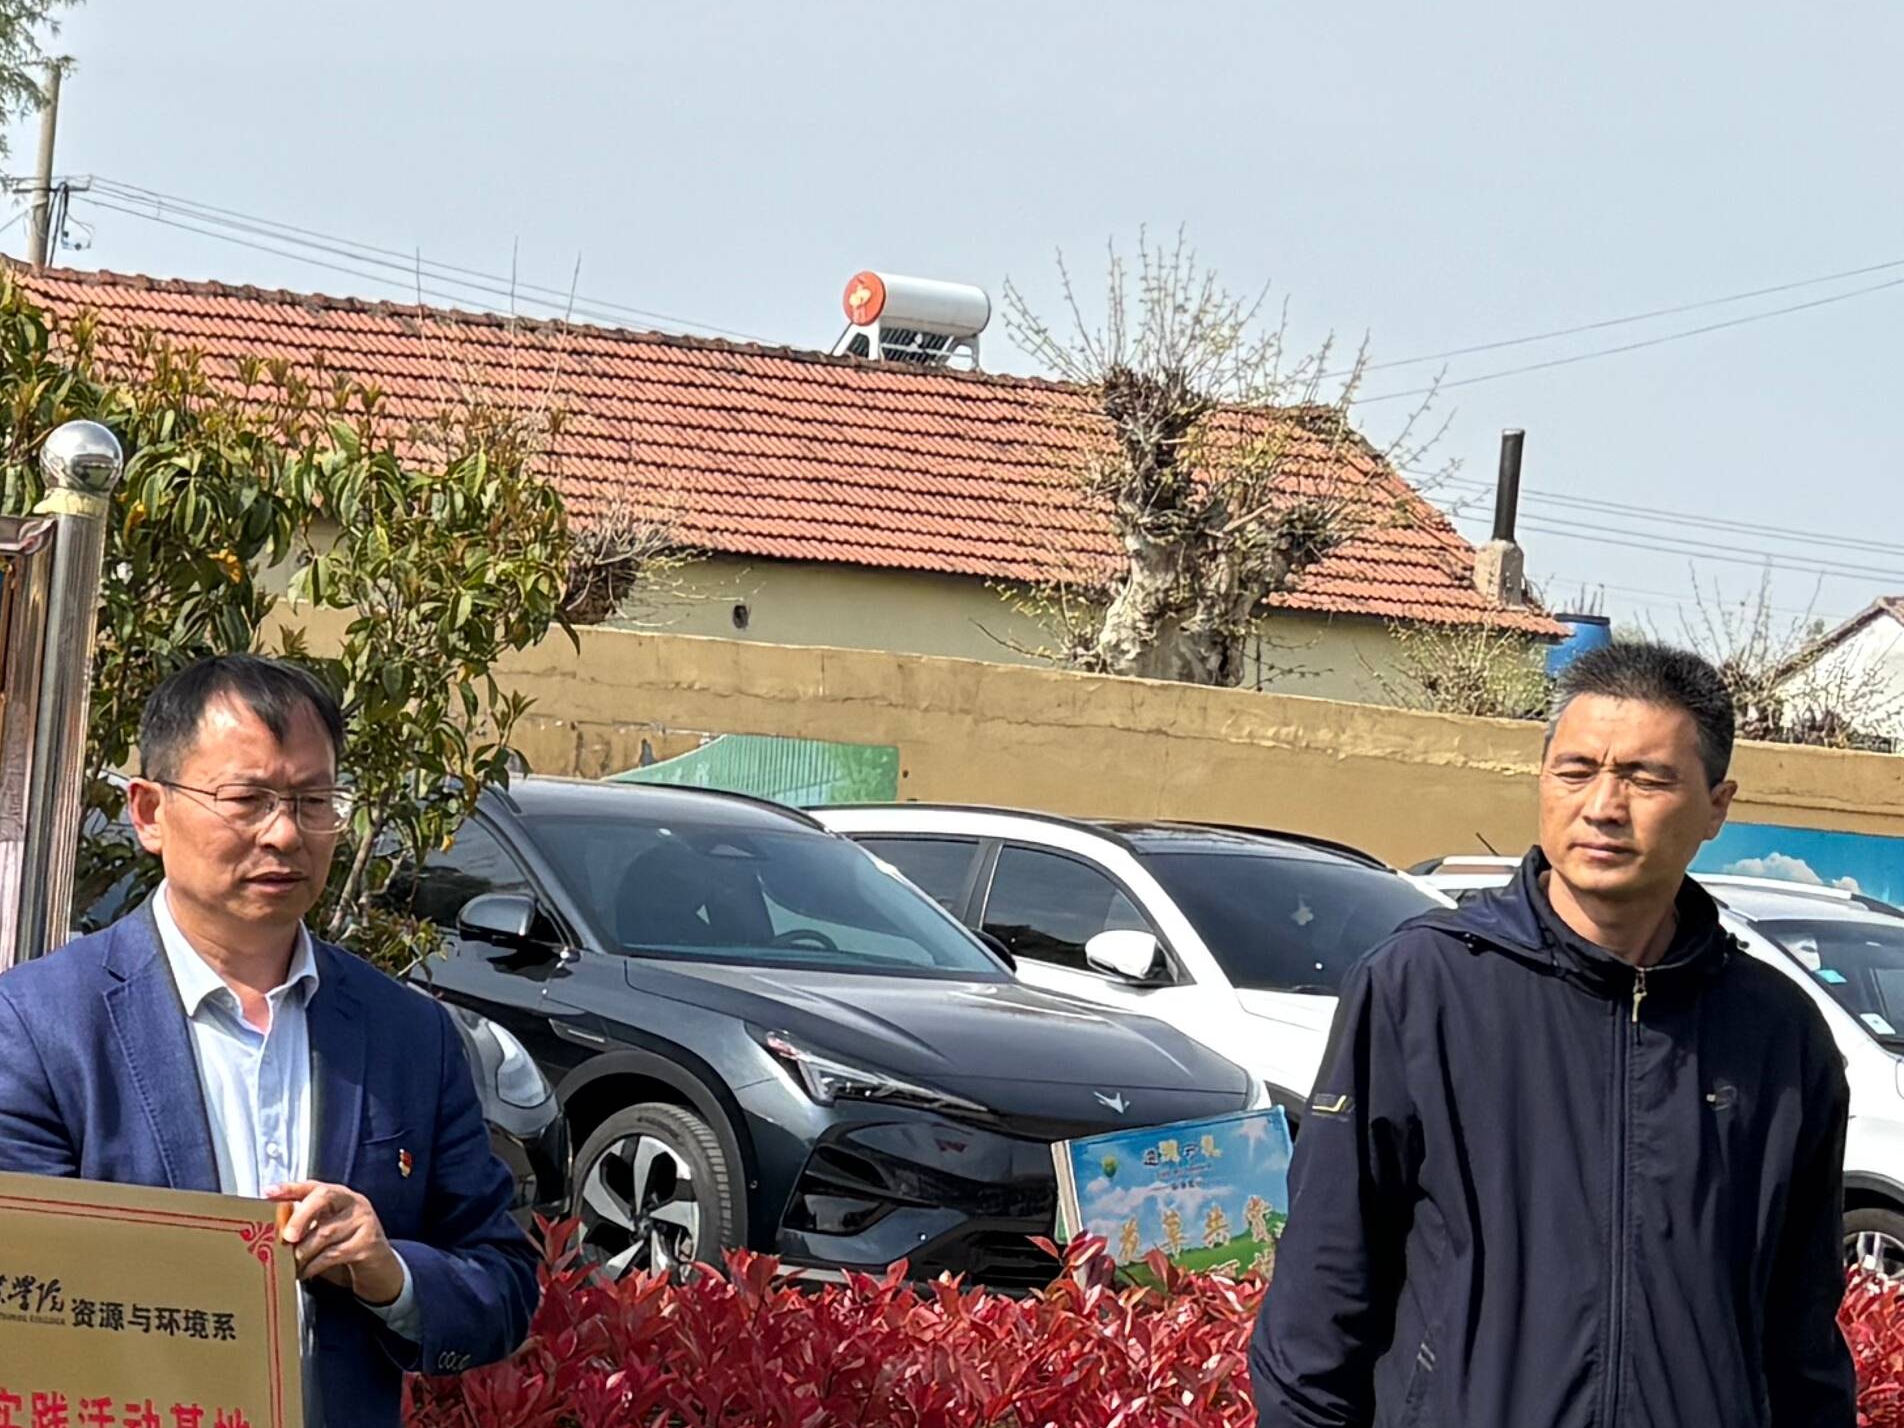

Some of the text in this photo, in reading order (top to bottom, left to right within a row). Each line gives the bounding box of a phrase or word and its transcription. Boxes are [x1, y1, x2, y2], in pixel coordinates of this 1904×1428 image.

[70, 1298, 237, 1341] 资源与环境系
